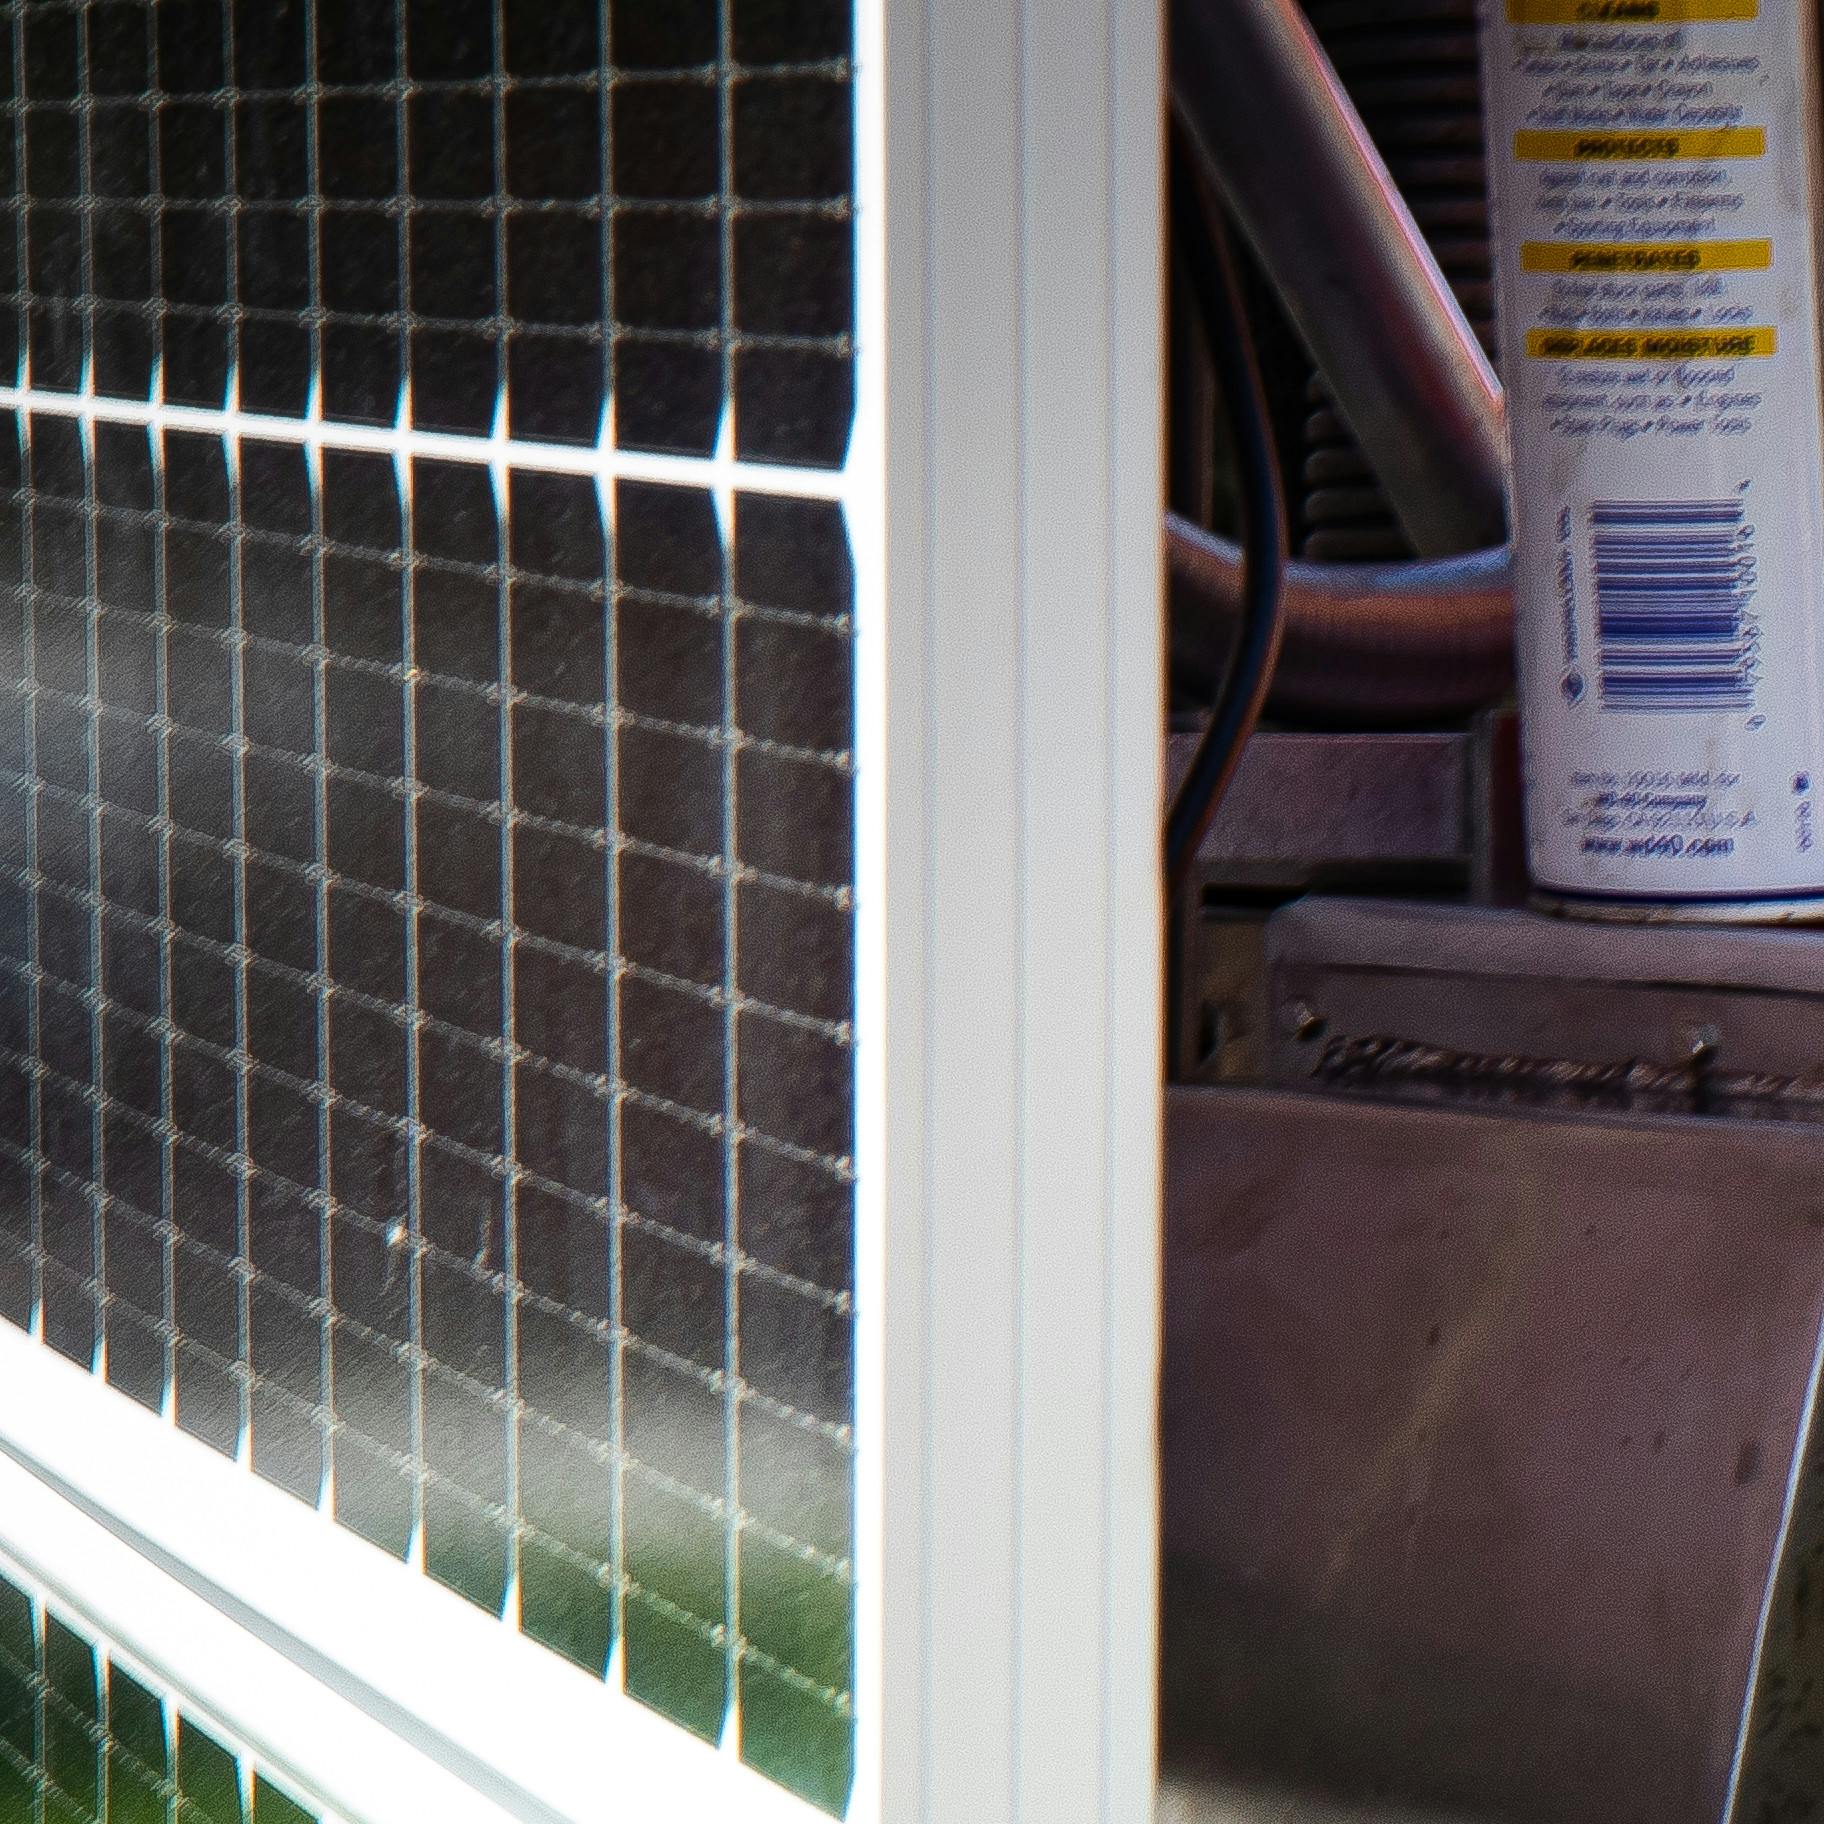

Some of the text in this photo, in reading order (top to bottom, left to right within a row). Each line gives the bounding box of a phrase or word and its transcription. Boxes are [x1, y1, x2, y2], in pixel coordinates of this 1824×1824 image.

[1573, 136, 1681, 159] PROTECTS
[1570, 248, 1702, 272] PENETRATES
[1540, 333, 1758, 360] DISPLACES MOISTURE
[1580, 833, 1735, 858] www.wd40.com
